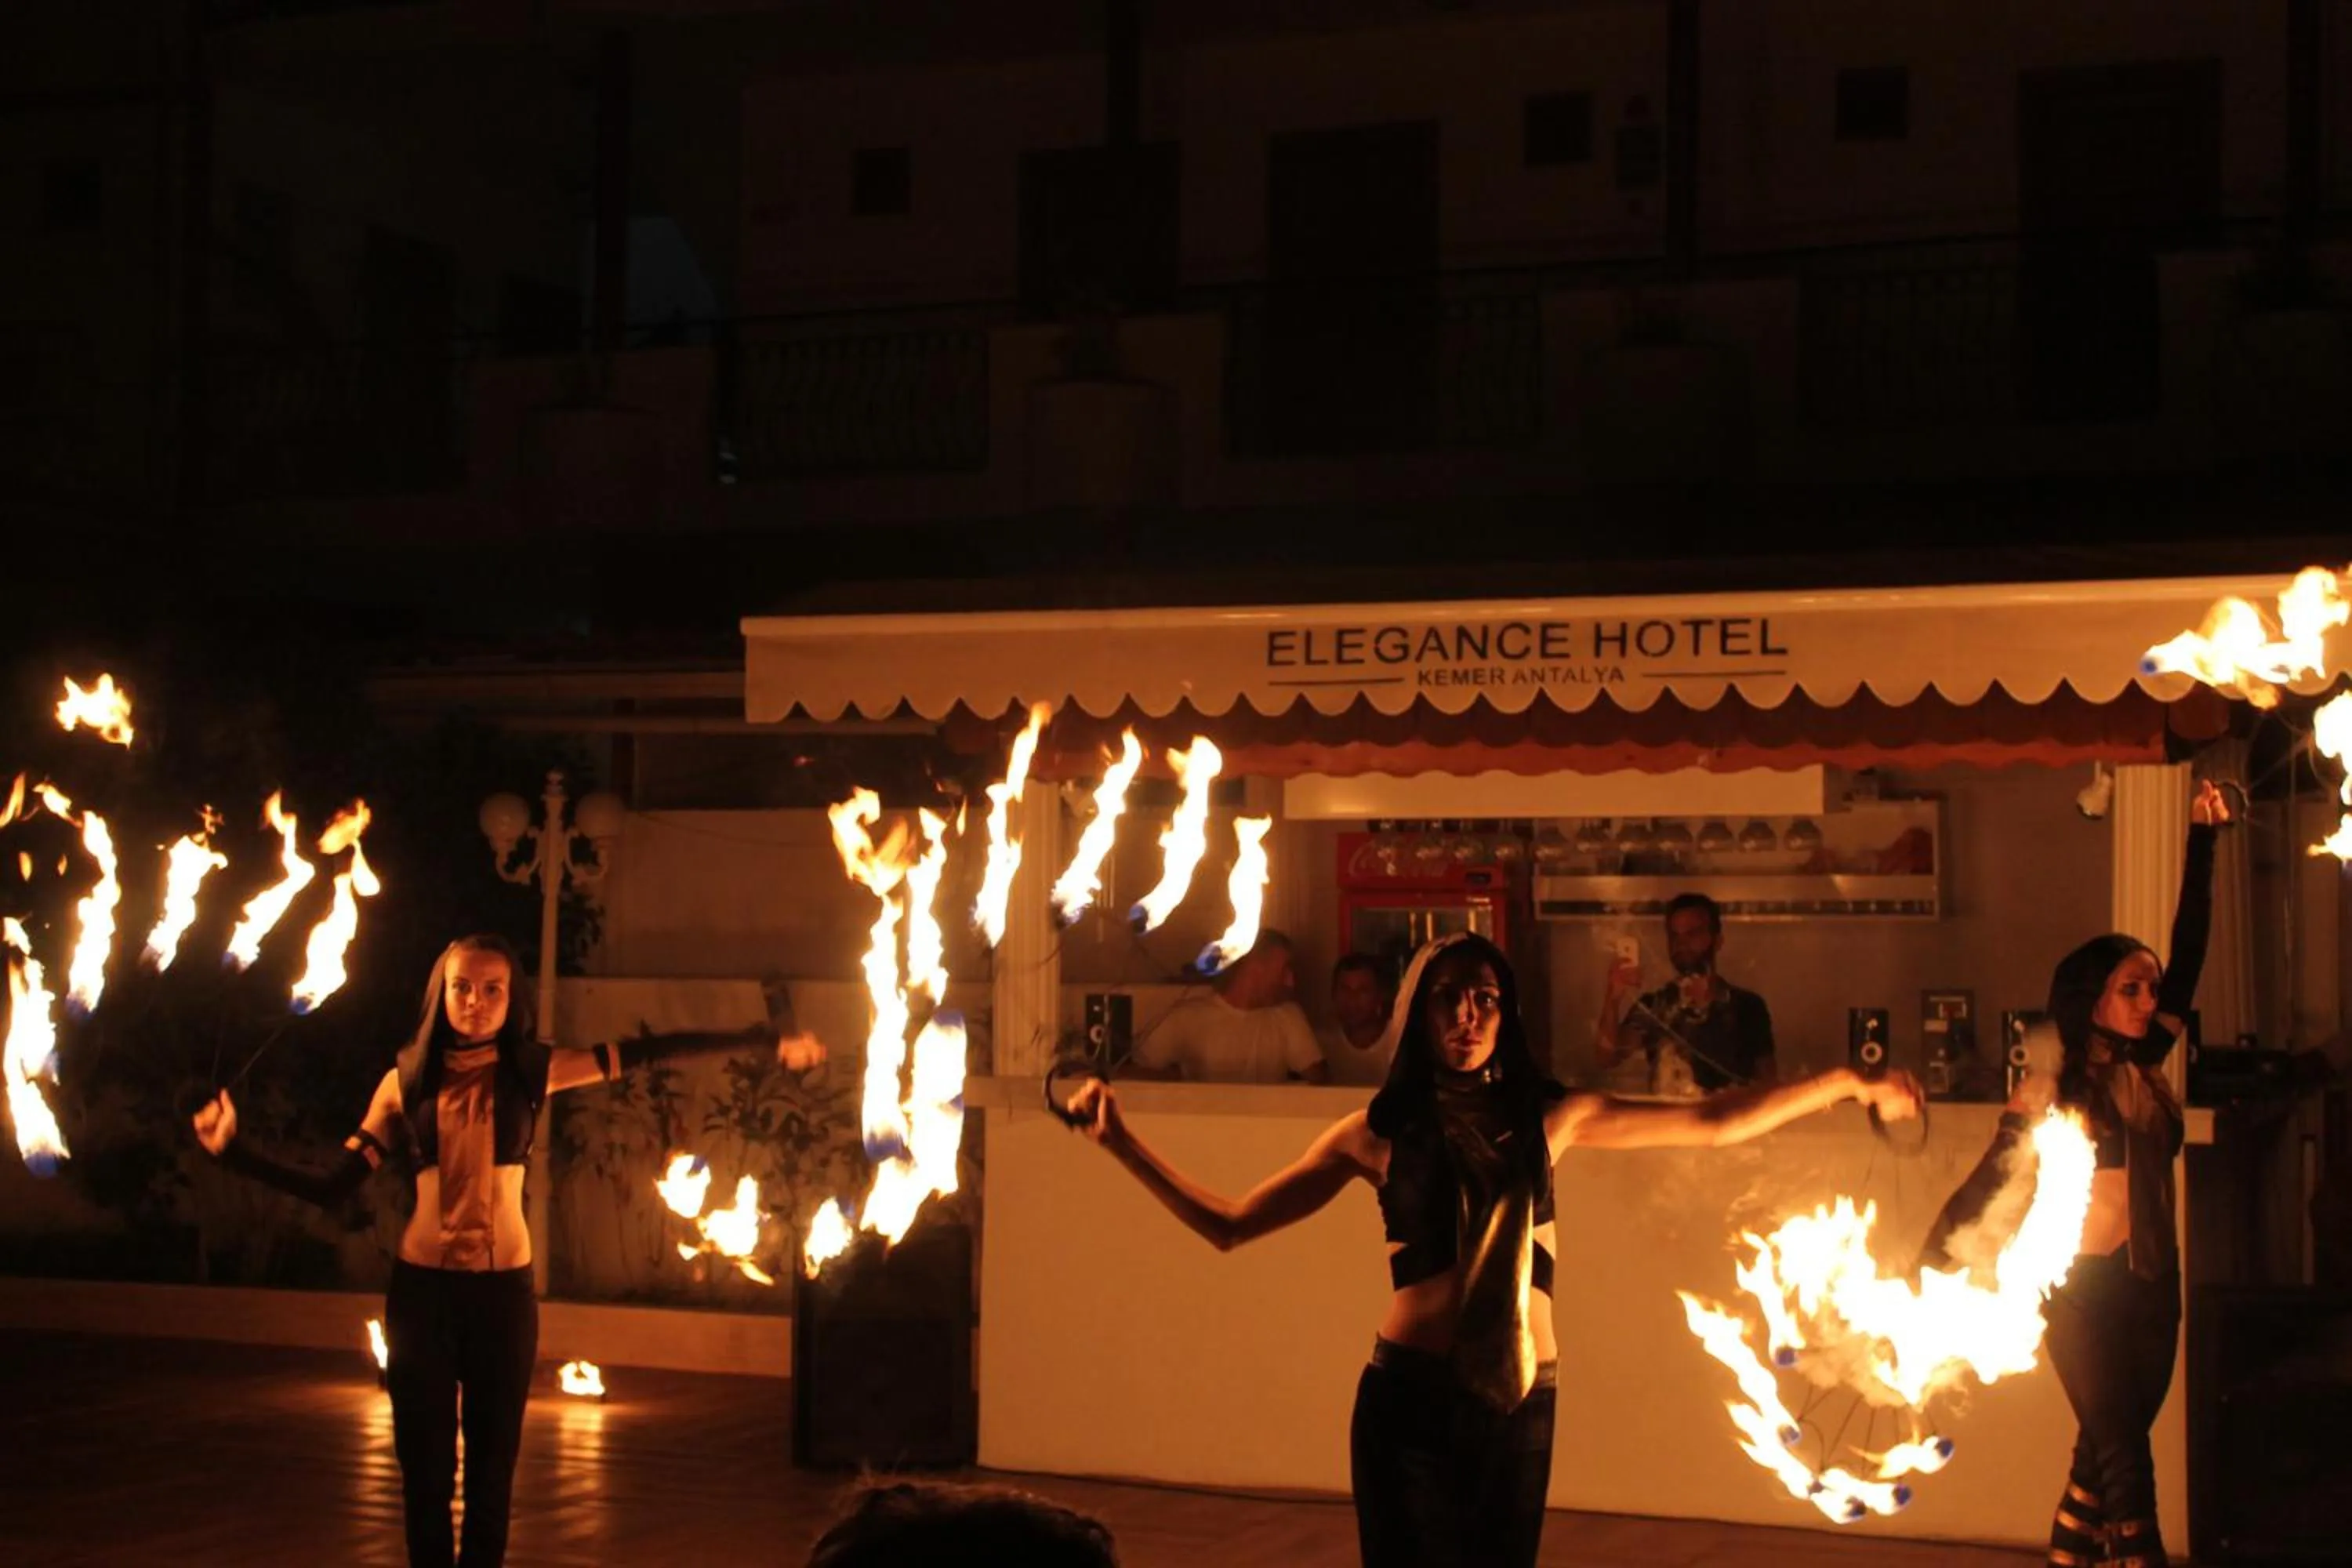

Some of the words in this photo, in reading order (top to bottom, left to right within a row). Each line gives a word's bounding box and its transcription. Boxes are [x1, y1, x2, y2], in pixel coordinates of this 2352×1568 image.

[1267, 622, 1570, 666] ELEGANCE
[1594, 619, 1788, 658] HOTEL
[1417, 668, 1505, 686] KEMER
[1512, 666, 1624, 684] ANTALYA
